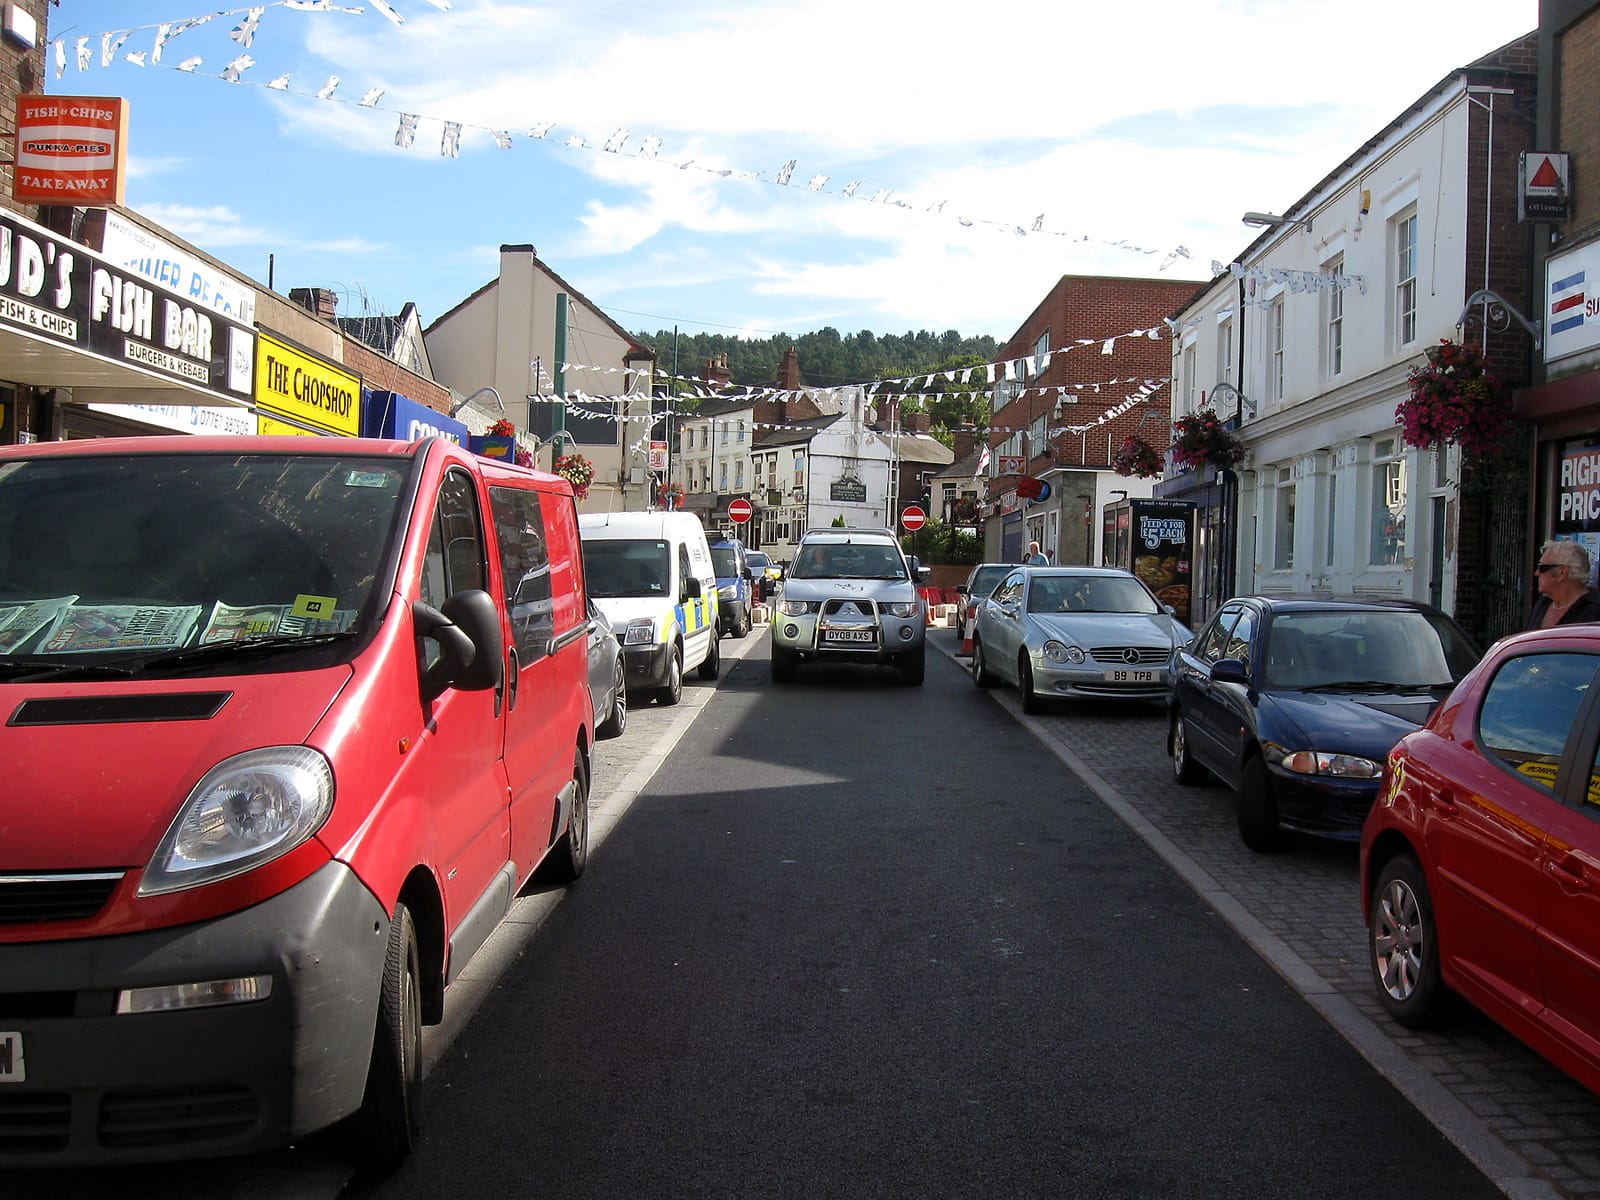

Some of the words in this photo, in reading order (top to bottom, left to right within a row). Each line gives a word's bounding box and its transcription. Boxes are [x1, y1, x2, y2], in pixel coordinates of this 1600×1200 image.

[25, 107, 58, 119] FISH
[69, 107, 113, 121] CHIPS
[21, 175, 110, 190] TAKEAWAY
[0, 299, 25, 321] FISH
[29, 309, 37, 325] &
[41, 313, 73, 336] CHIPS
[91, 267, 154, 341] FISH
[164, 298, 214, 363] BAR
[128, 342, 168, 367] BURGERS
[177, 360, 207, 381] KEBABS
[267, 354, 290, 395] THE
[293, 366, 353, 419] CHOPSHOP
[1169, 521, 1183, 529] FOR
[1159, 528, 1183, 538] EACH
[828, 630, 851, 640] DY08
[853, 631, 869, 641] AXS
[1114, 670, 1127, 681] B9
